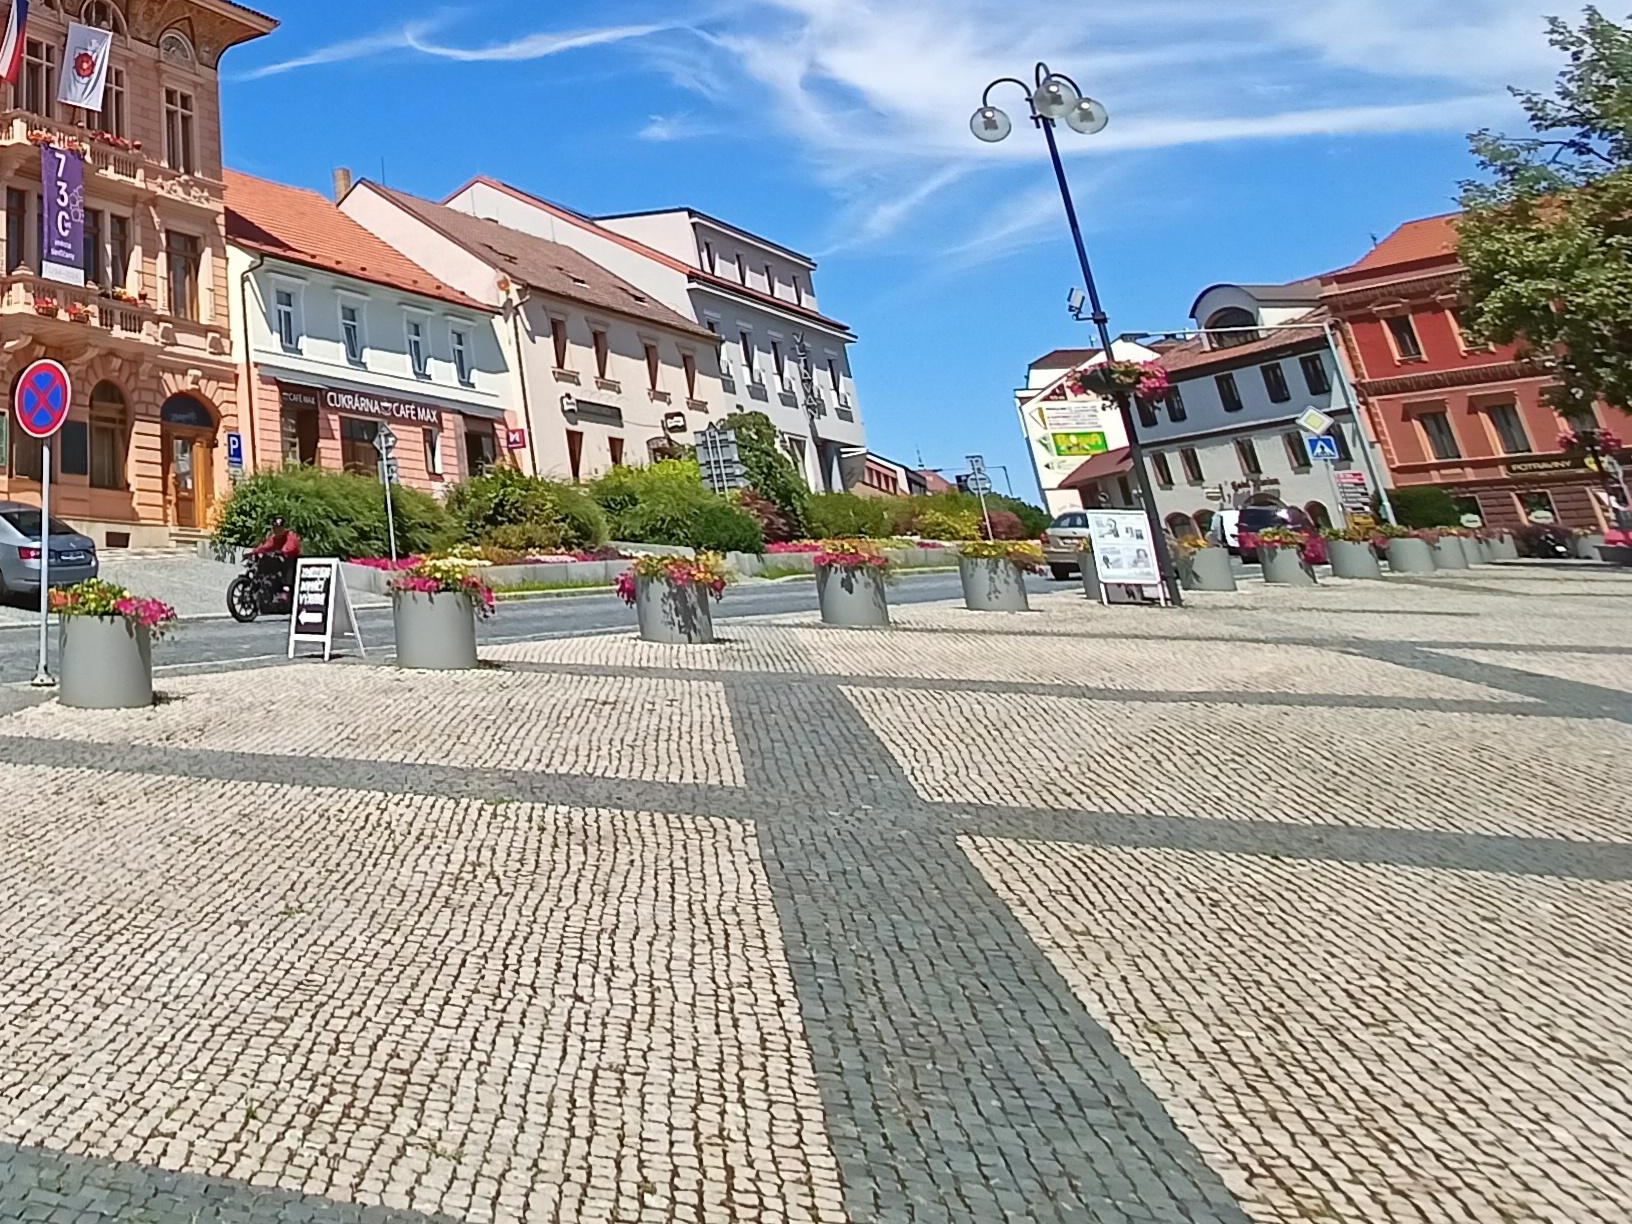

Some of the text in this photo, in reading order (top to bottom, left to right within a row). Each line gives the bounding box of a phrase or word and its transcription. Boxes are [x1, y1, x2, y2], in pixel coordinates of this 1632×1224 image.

[792, 331, 822, 421] VLTAVAN
[327, 391, 439, 424] CUKRÁRNA CAFÉ MAX
[230, 436, 239, 456] P
